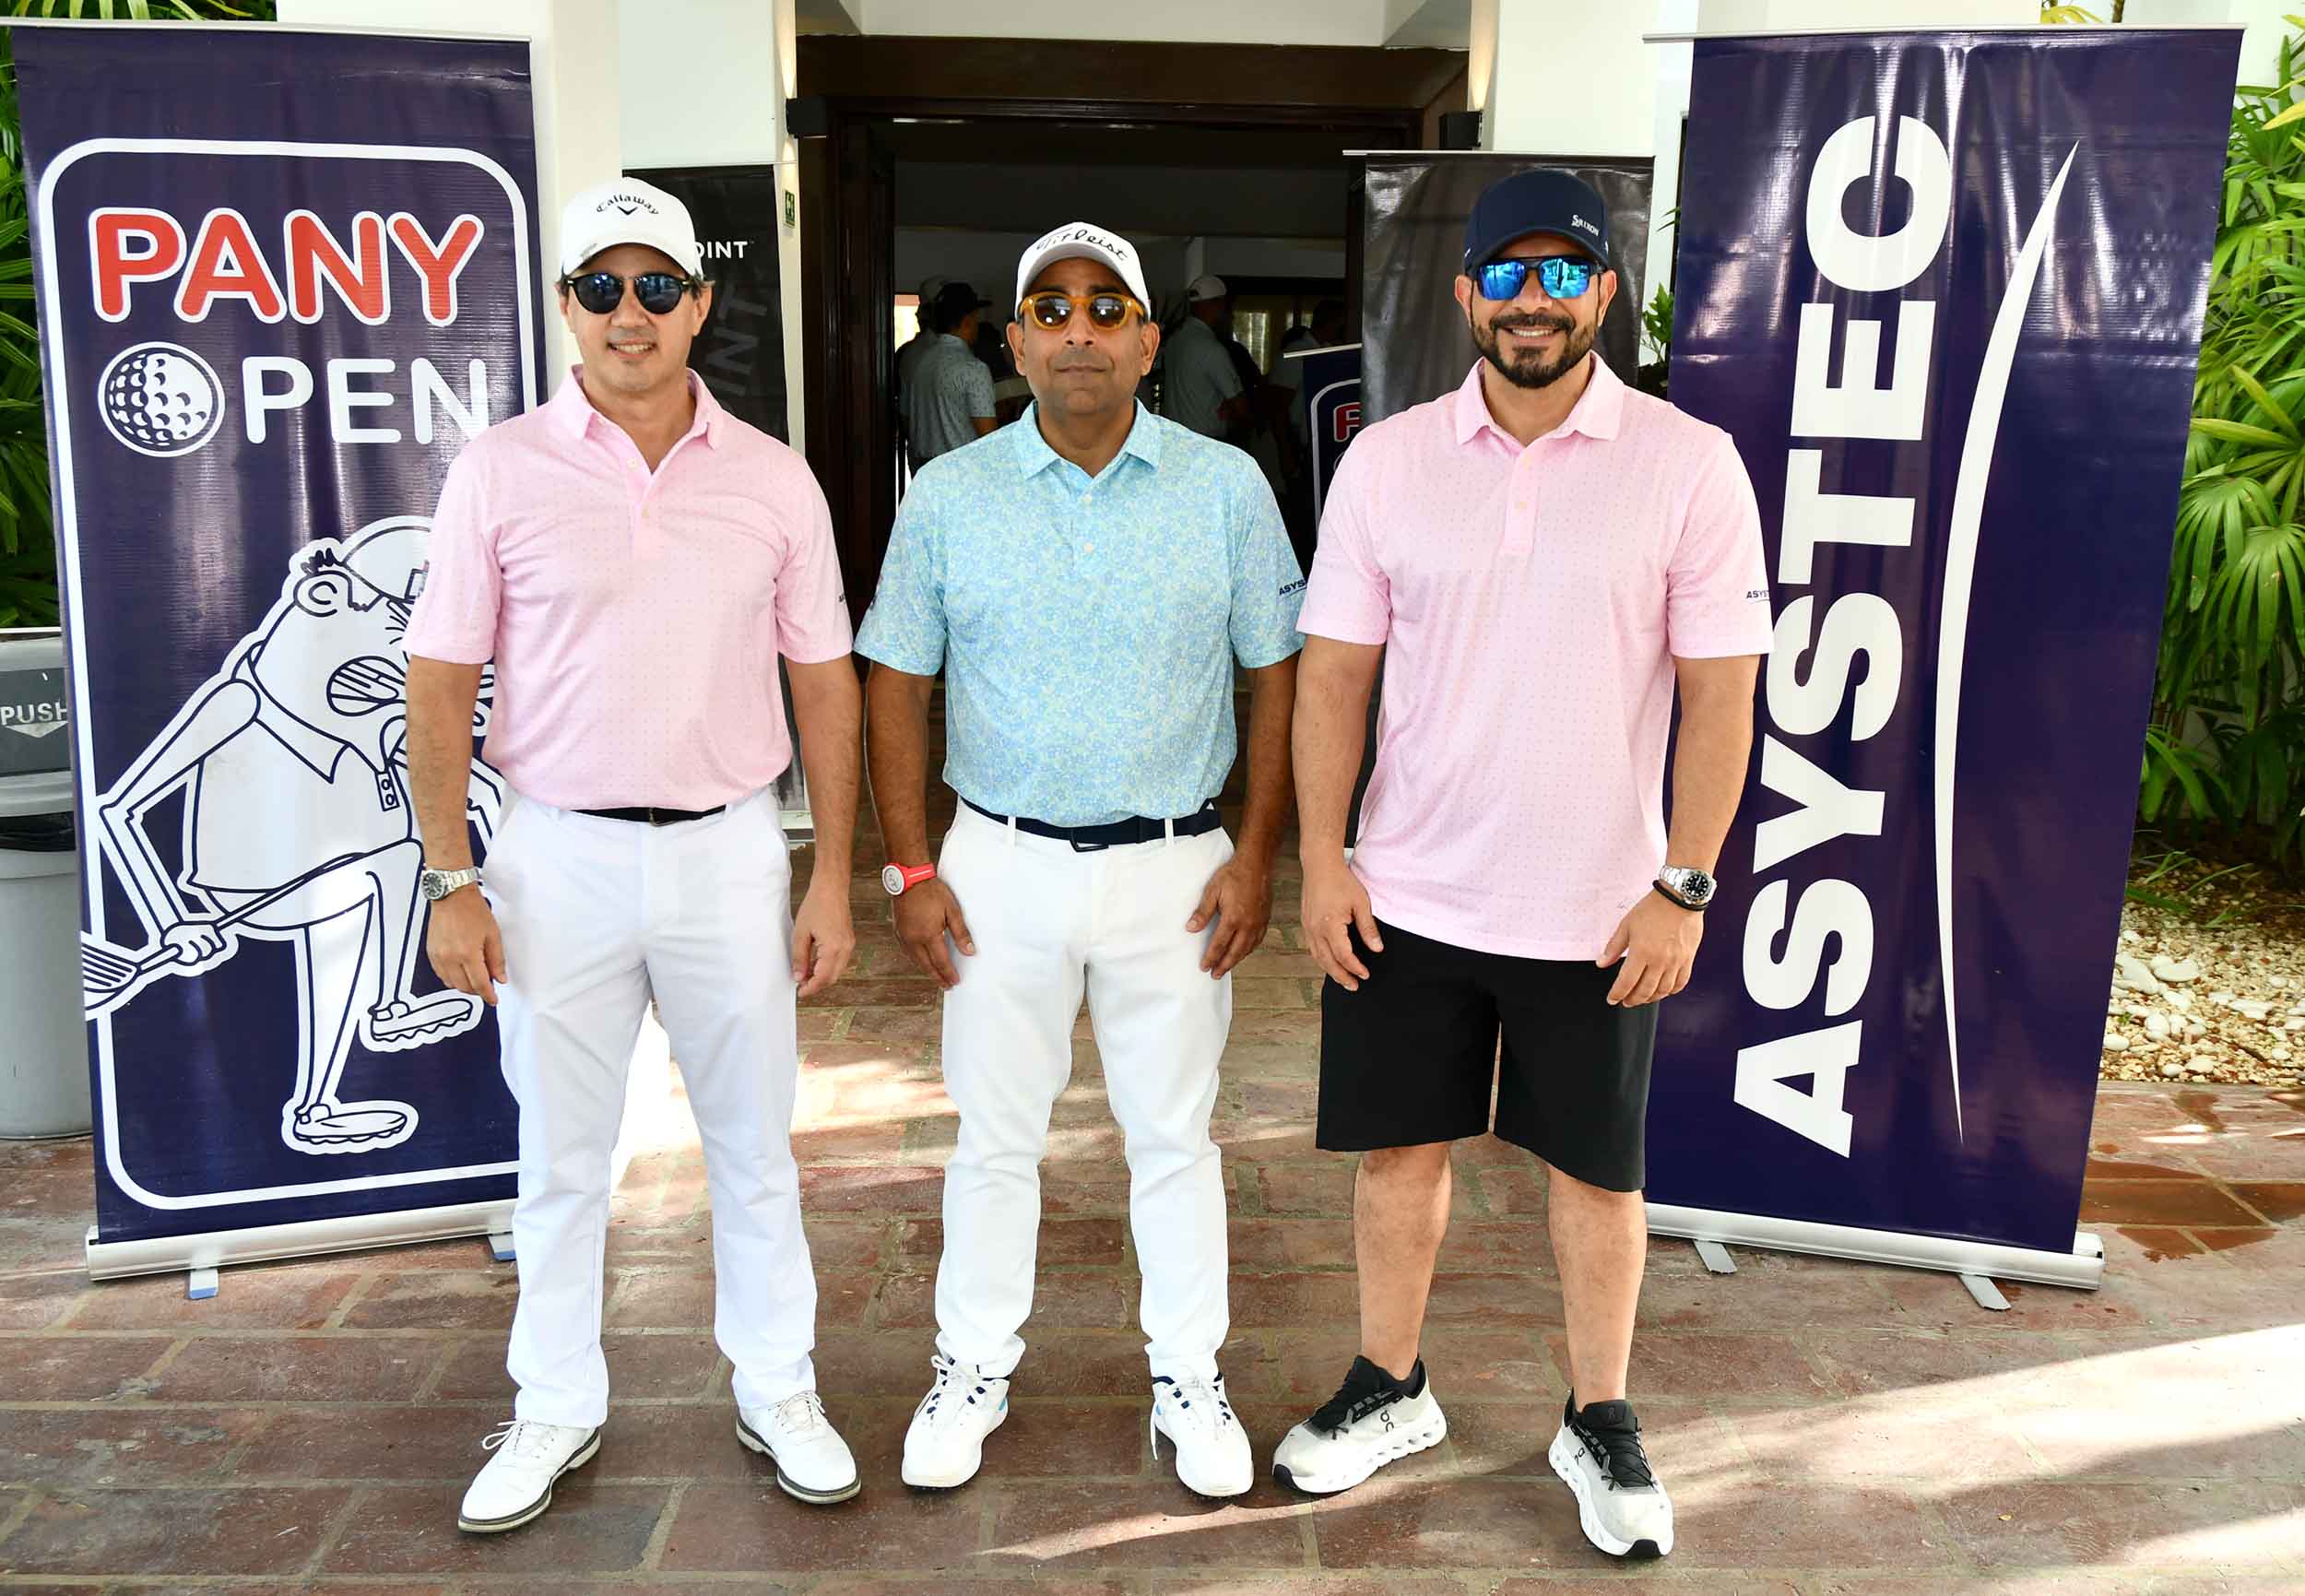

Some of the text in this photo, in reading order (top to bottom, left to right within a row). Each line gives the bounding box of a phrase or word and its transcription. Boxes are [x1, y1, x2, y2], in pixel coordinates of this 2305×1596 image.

[596, 194, 659, 215] Callaway
[89, 207, 485, 327] PANY
[1733, 112, 1952, 1159] ASYSTEC
